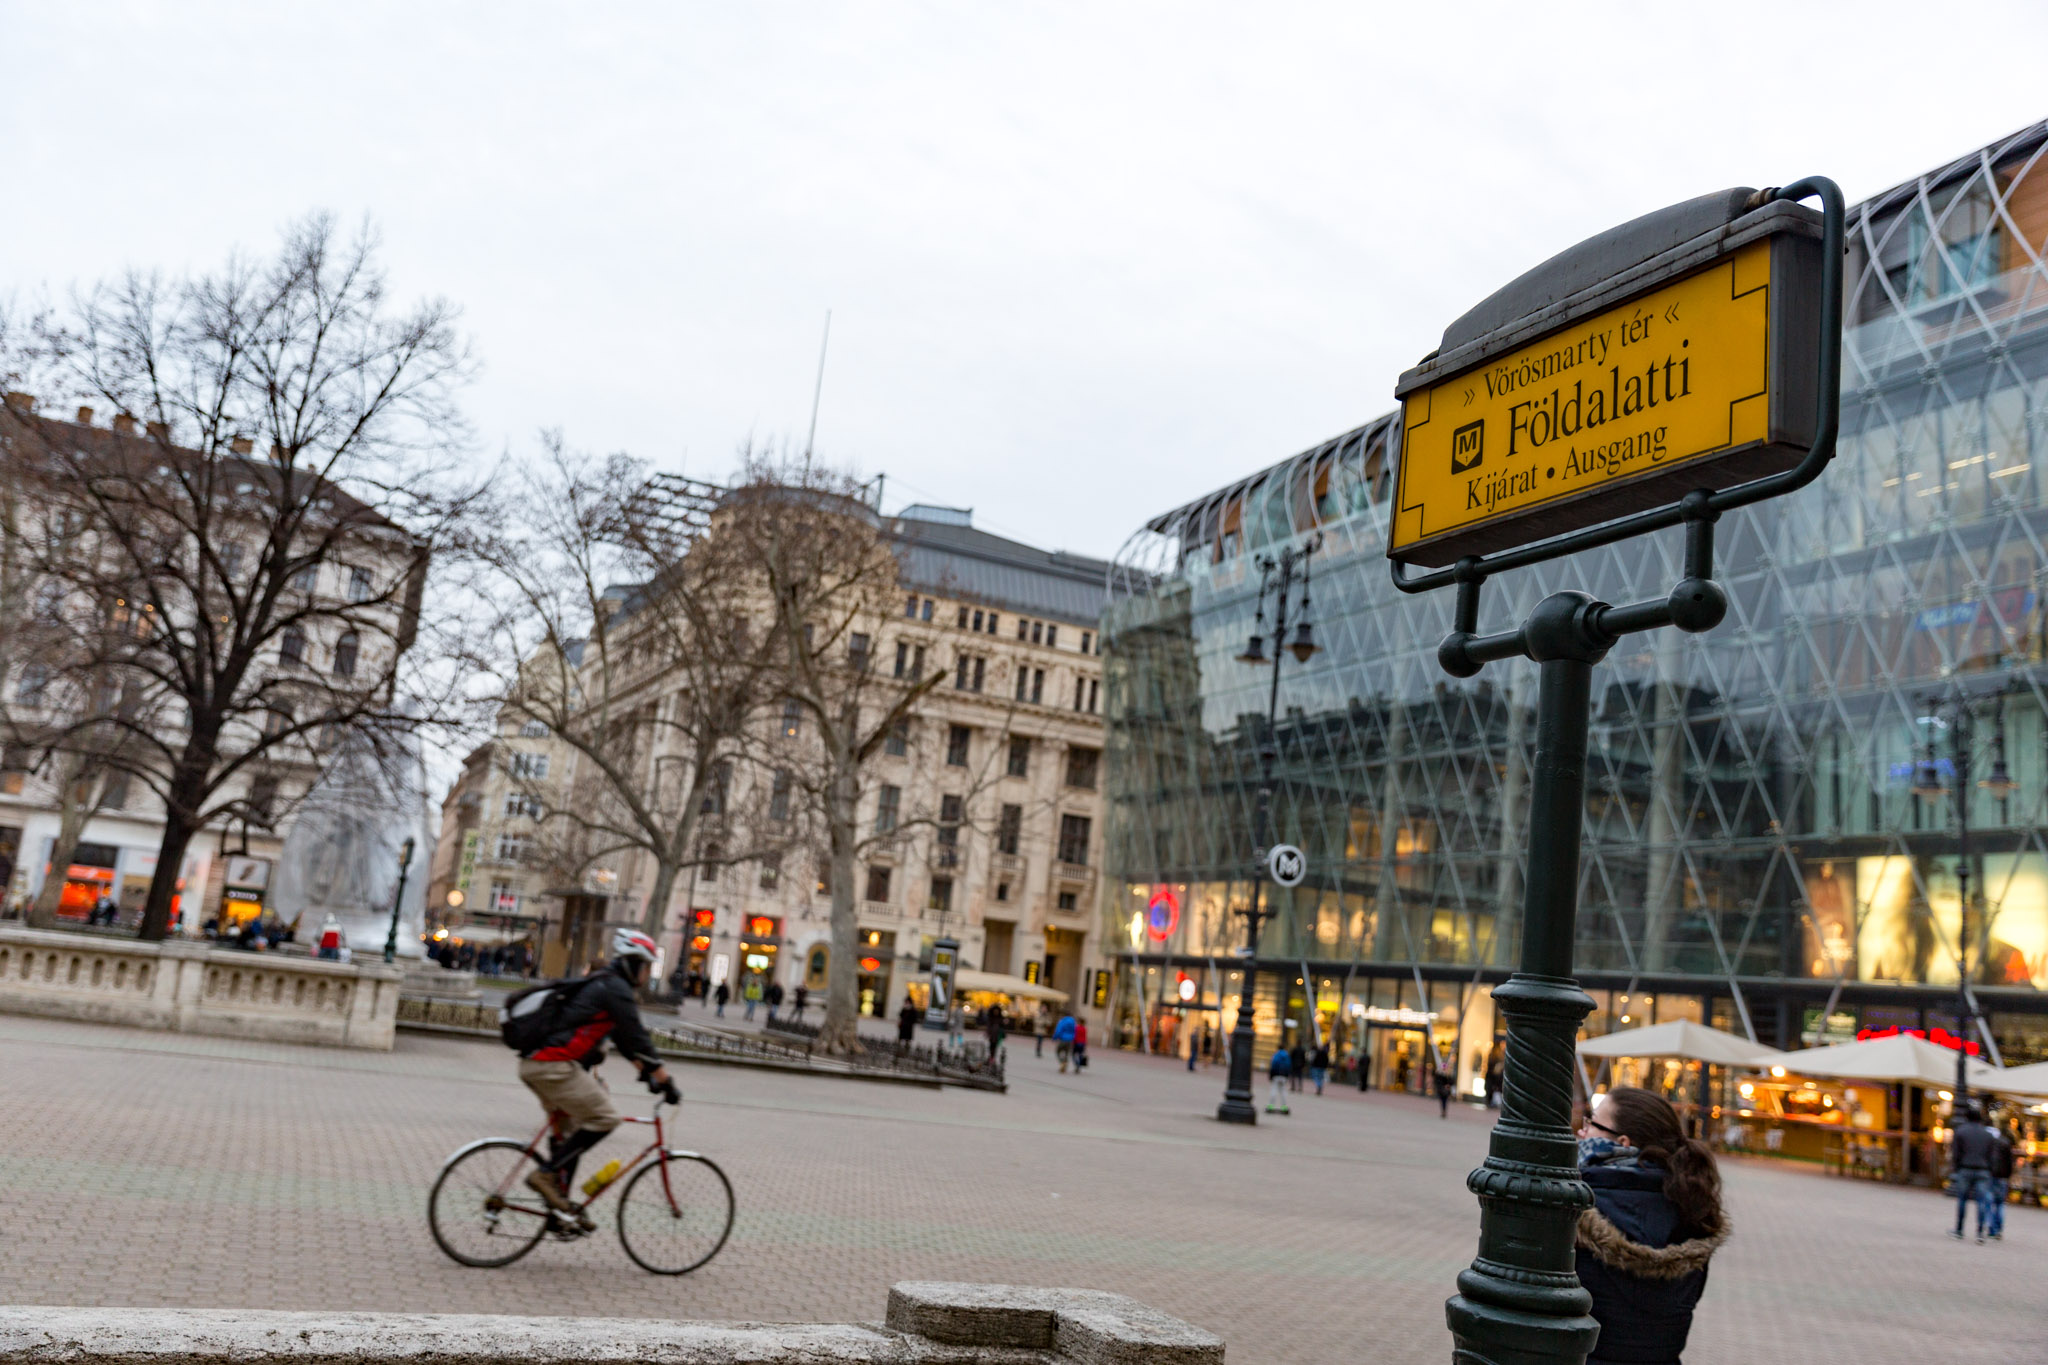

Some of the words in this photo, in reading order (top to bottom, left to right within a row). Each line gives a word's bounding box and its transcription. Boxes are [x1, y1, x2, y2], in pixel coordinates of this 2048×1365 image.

[1484, 329, 1612, 400] Vörösmarty
[1620, 309, 1654, 347] tér
[1506, 338, 1692, 457] Földalatti
[1459, 430, 1477, 455] M
[1466, 465, 1537, 512] Kijárat
[1562, 427, 1668, 480] Ausgang
[1279, 852, 1300, 878] M
